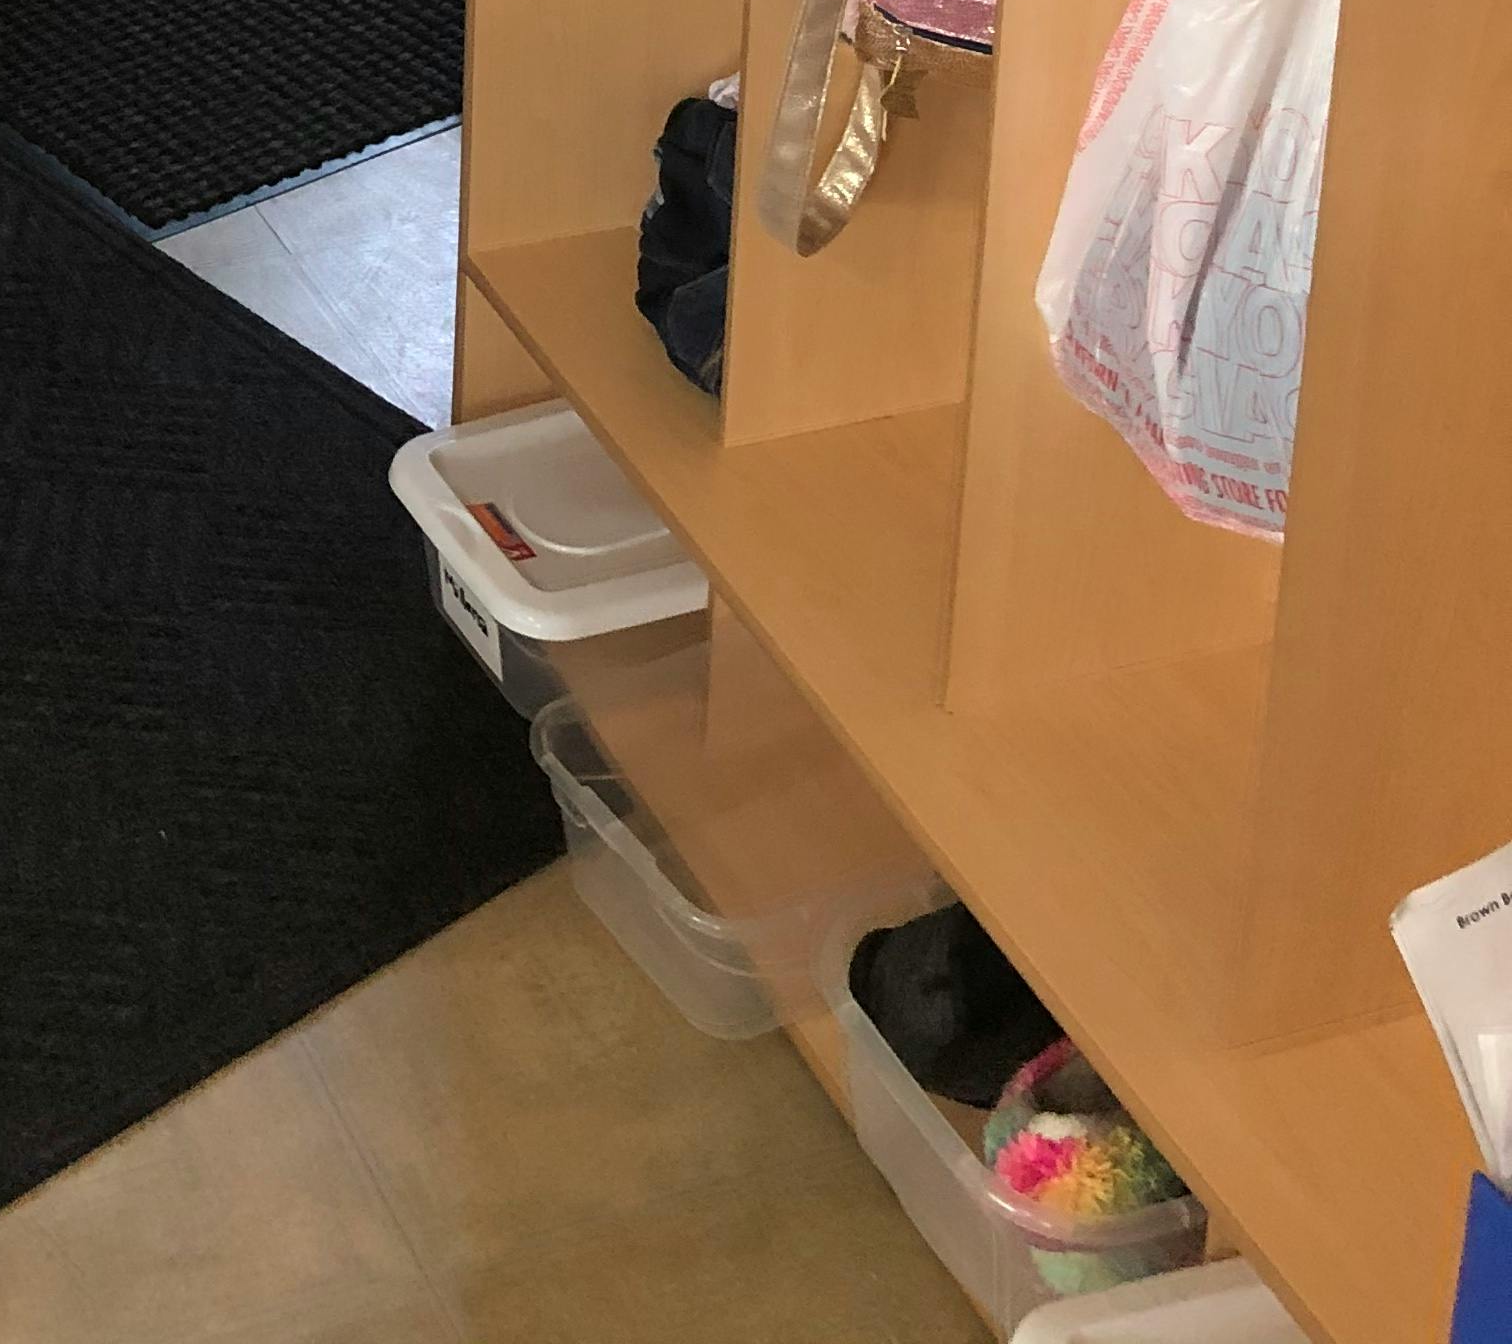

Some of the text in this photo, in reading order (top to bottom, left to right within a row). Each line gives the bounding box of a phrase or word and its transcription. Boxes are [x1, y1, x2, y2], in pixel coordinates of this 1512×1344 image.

[1209, 474, 1266, 512] STORE
[1266, 485, 1288, 514] FO
[1456, 900, 1500, 929] Brown
